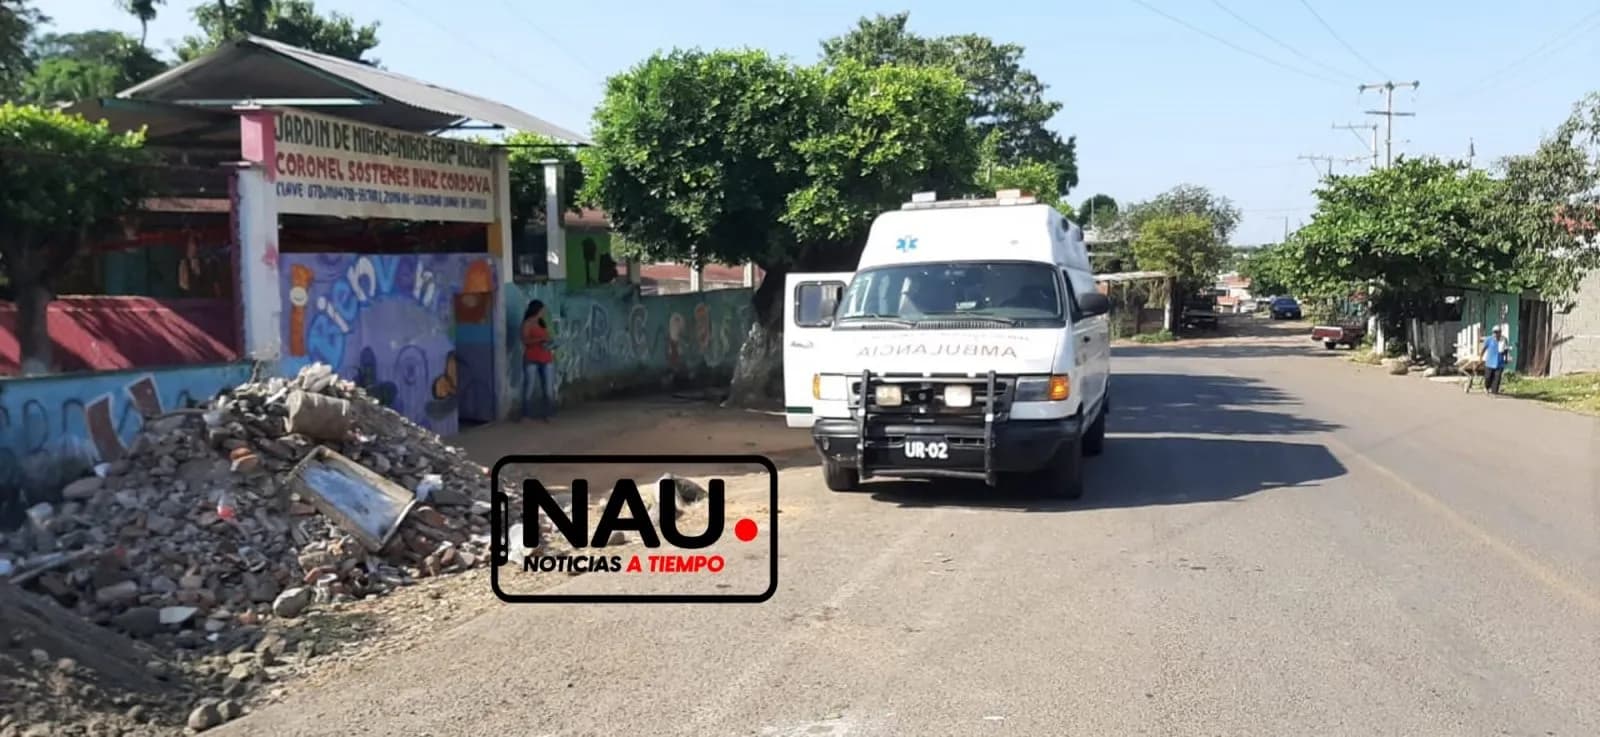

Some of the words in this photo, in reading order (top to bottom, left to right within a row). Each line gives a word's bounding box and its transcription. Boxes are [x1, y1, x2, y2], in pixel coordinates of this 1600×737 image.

[275, 111, 331, 149] JARDIN
[333, 122, 351, 152] DE
[275, 151, 345, 182] CORONEL
[348, 160, 410, 187] SOSTENES
[412, 168, 439, 189] RUIZ
[905, 440, 949, 459] UR-02
